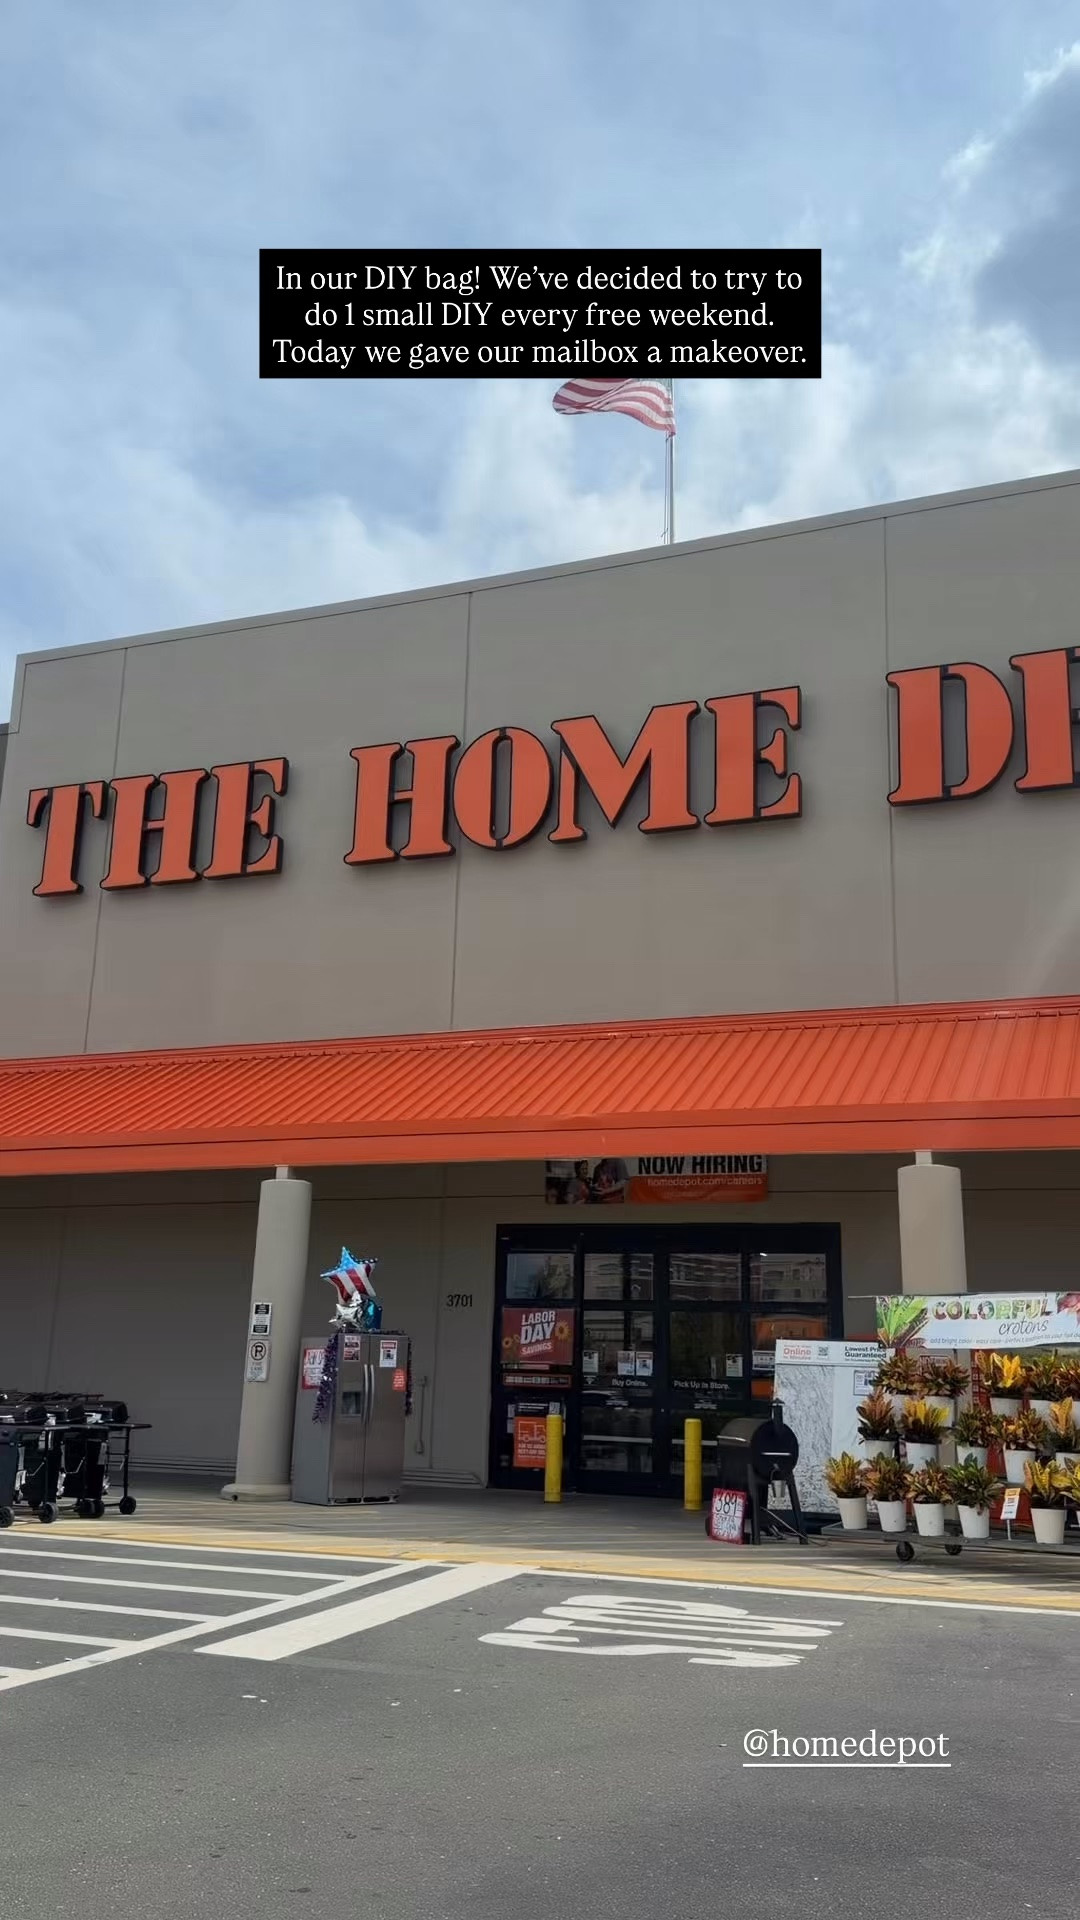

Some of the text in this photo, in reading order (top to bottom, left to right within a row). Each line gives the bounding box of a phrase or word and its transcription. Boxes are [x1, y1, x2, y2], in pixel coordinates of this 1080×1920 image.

[26, 757, 290, 897] THE
[343, 685, 802, 866] HOME
[638, 1154, 763, 1175] NOW HIRING
[648, 1176, 763, 1187] homedepot.com/careers
[447, 1294, 473, 1307] 3701
[932, 1298, 1053, 1320] COLORFUL
[521, 1310, 556, 1325] LABOR
[998, 1315, 1049, 1336] crotons
[520, 1322, 556, 1345] DAY
[521, 1342, 553, 1355] SAVINGS
[844, 1351, 887, 1359] Guaranteed
